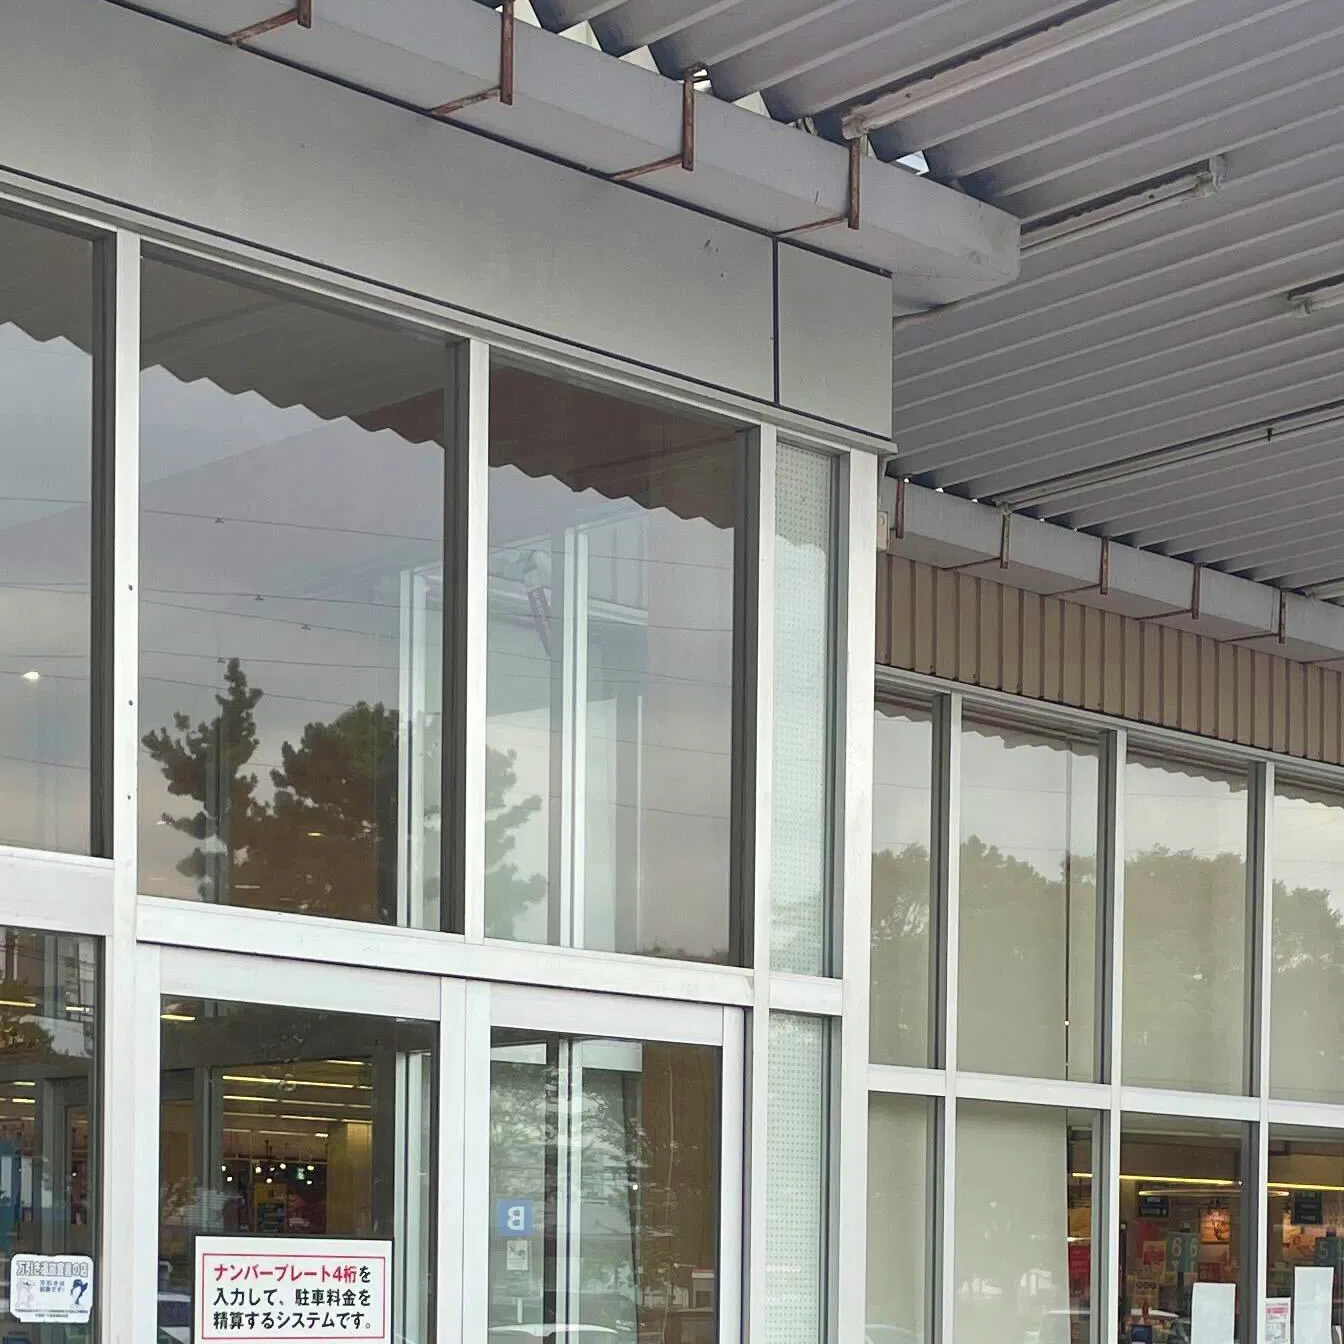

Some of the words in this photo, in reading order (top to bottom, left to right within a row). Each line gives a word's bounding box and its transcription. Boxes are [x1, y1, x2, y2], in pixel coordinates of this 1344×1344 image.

[214, 1264, 371, 1284] ナンバープレート4桁を
[213, 1288, 371, 1306] 入力して、駐車料金を
[213, 1311, 370, 1330] 精算するシステムです。
